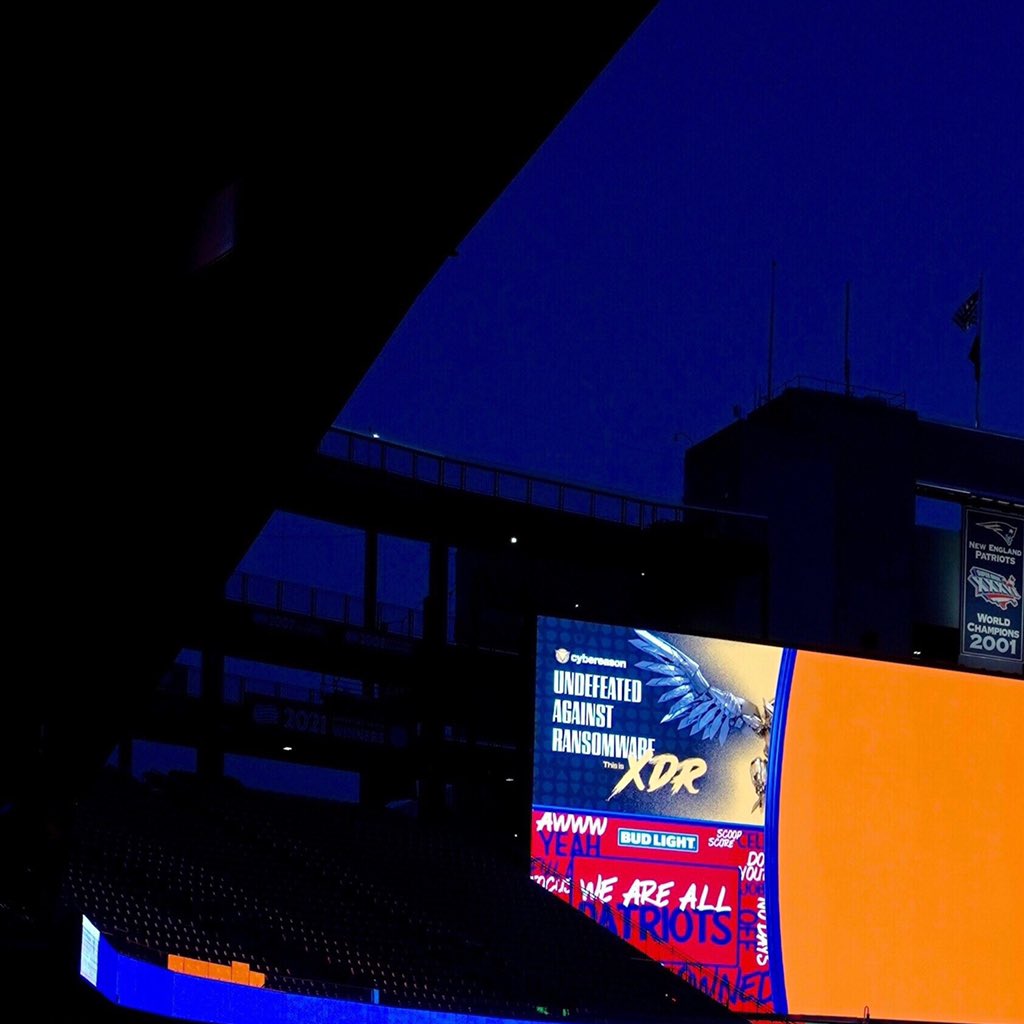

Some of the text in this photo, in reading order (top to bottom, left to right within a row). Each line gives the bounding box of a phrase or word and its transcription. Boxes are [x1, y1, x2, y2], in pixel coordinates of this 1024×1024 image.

[969, 541, 1022, 557] NEW ENGLAND
[975, 550, 1016, 565] PATRIOTS
[977, 613, 1011, 627] WORLD
[967, 622, 1020, 639] CHAMPIONS
[969, 634, 1017, 655] 2001
[571, 652, 627, 669] cybereason
[553, 670, 642, 703] UNDEFEATED
[552, 699, 614, 728] AGAINST
[552, 728, 656, 759] RANSOMWARE
[603, 761, 616, 769] This
[605, 751, 708, 802] XDR
[536, 812, 607, 836] AWWW
[620, 831, 696, 849] BUD LIGHT
[708, 837, 736, 848] SCORE
[717, 829, 742, 840] SCOOP
[538, 831, 601, 857] YEAH
[747, 851, 765, 868] DO
[580, 874, 732, 912] WE ARE ALL
